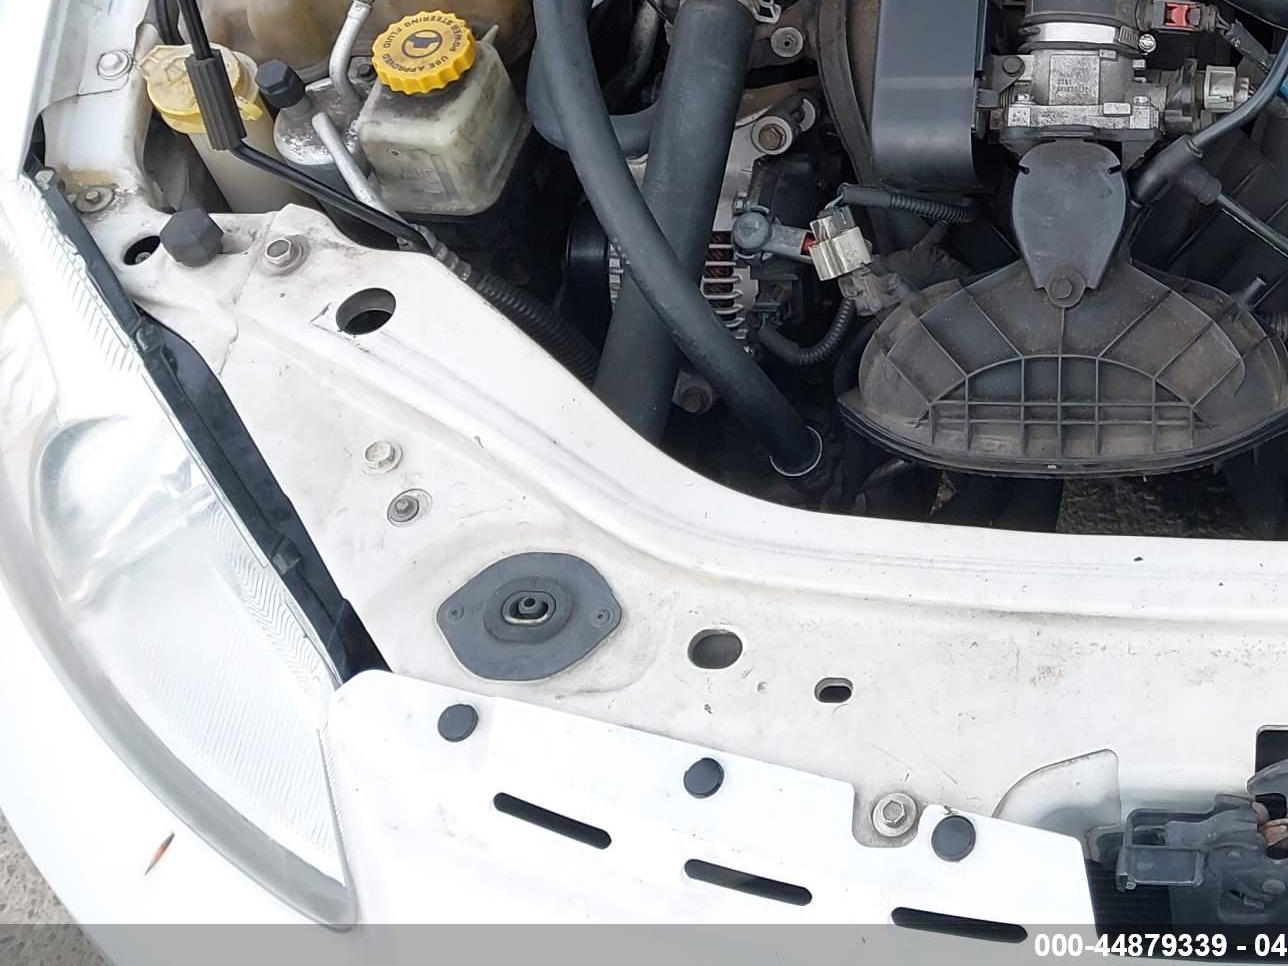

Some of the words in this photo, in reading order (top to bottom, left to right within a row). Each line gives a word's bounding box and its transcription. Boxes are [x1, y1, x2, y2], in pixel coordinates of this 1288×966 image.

[404, 15, 453, 27] STEERING
[383, 28, 402, 48] FLUID
[450, 25, 463, 52] POWER
[382, 53, 424, 72] APPROVED
[429, 56, 448, 69] USE
